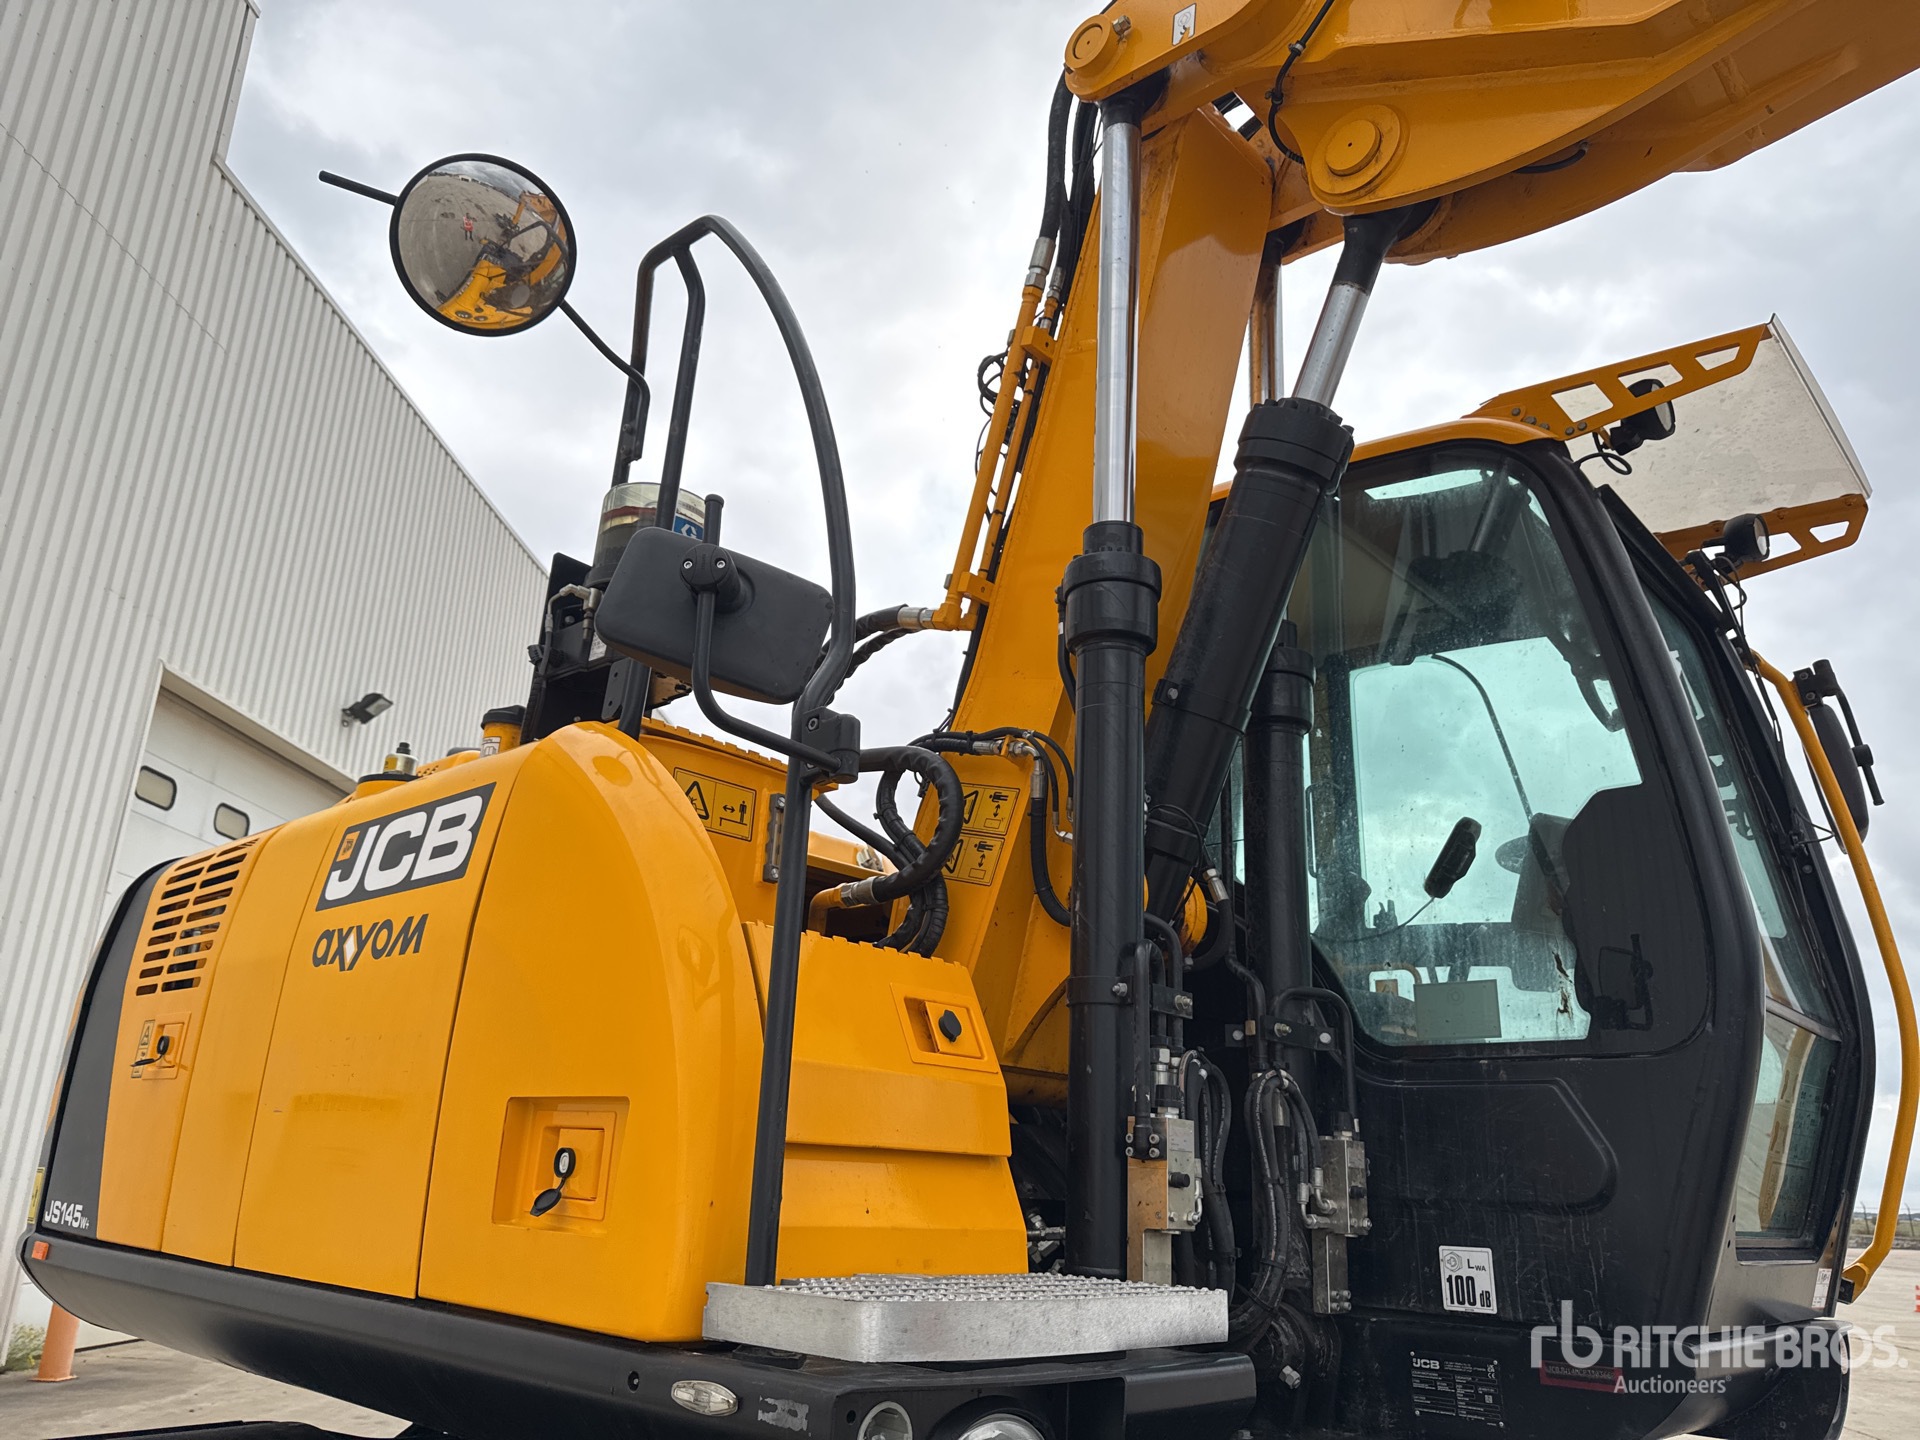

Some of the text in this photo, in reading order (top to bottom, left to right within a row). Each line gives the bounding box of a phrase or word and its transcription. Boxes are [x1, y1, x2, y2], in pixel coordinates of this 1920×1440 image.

[324, 795, 483, 901] JCB
[1446, 1274, 1492, 1308] 100 dB
[1413, 1357, 1440, 1370] JCB
